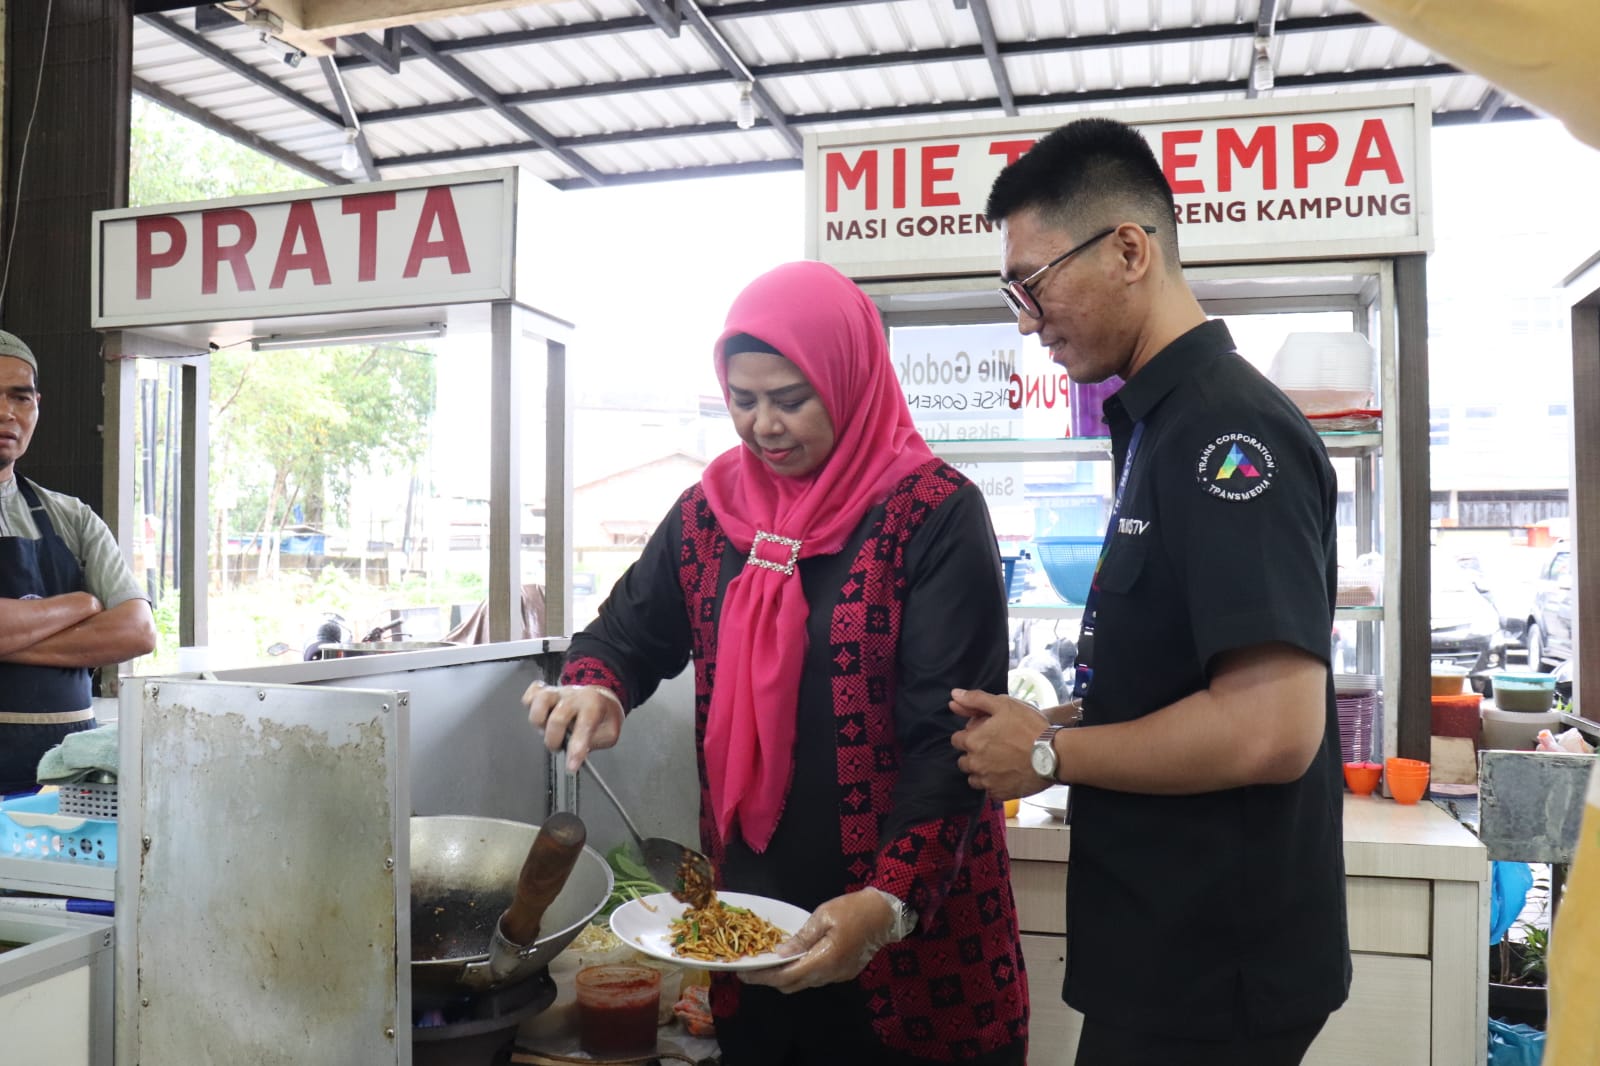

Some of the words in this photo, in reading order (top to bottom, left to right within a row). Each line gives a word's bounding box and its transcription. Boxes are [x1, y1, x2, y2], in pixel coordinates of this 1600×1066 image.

[826, 145, 961, 212] MIE
[987, 118, 1405, 206] TEMPA
[826, 218, 887, 241] NASI
[1257, 193, 1411, 221] KAMPUNG
[135, 185, 472, 300] PRATA
[1198, 443, 1216, 473] TRANS
[1215, 433, 1275, 469] CORPORATION
[1208, 479, 1271, 501] TRANSMEDIA
